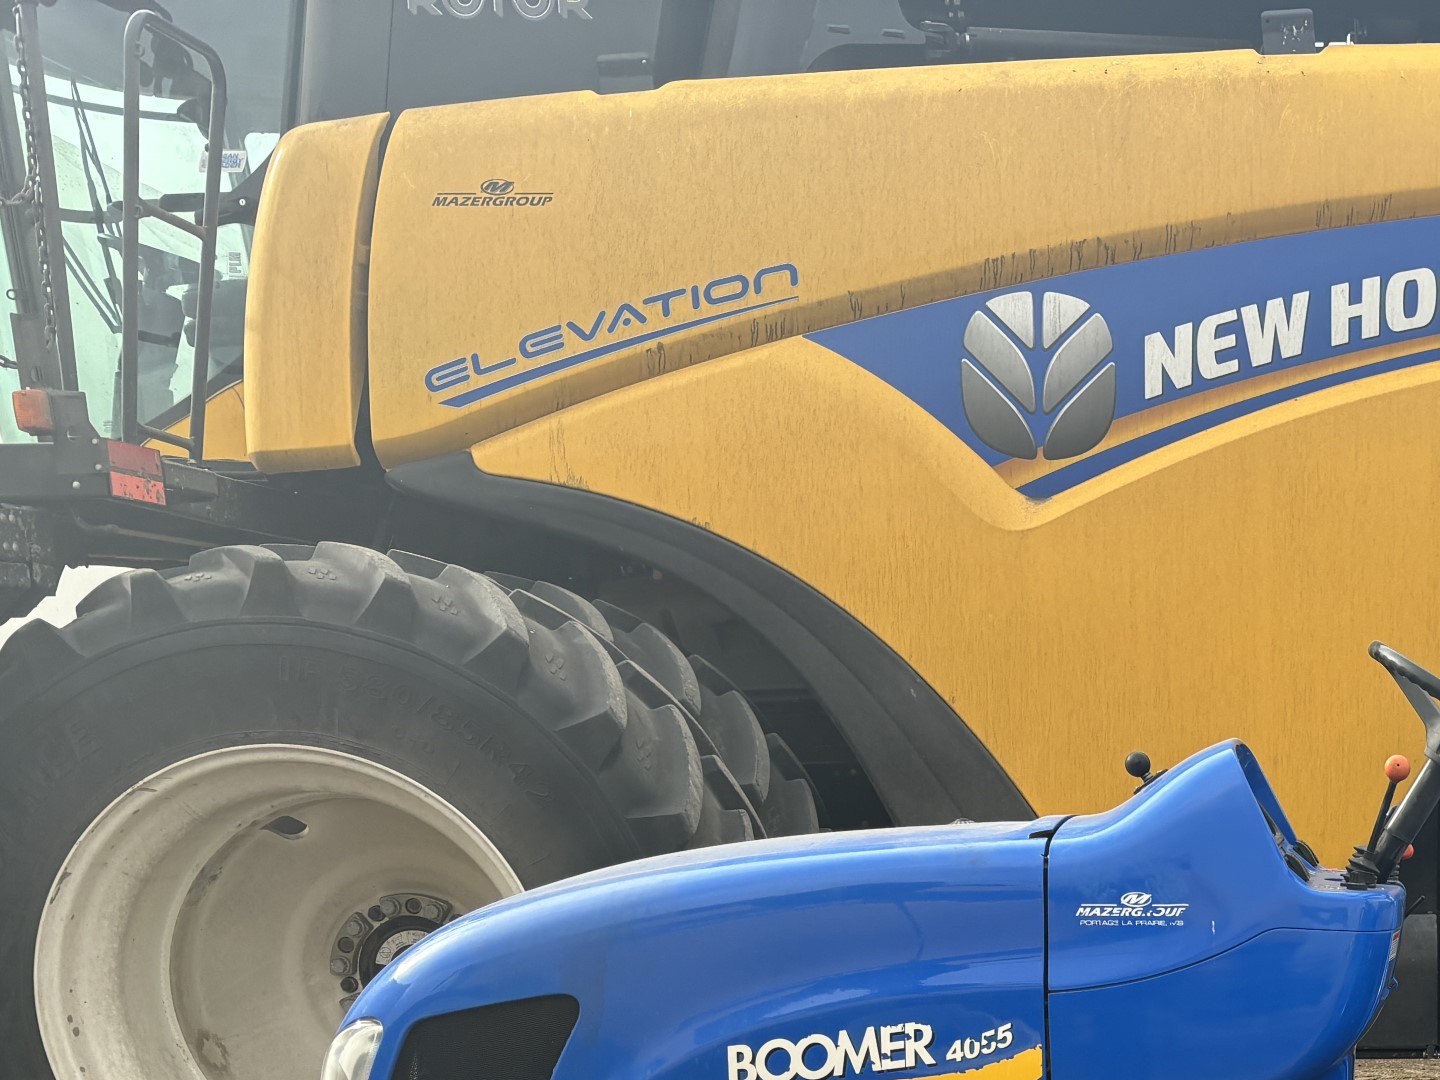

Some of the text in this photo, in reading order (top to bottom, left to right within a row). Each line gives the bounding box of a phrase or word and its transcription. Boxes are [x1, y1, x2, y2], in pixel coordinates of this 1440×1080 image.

[431, 196, 553, 207] MAZERGROUP
[424, 262, 800, 393] ELEVATION
[1144, 290, 1310, 400] NEW
[945, 1022, 1014, 1063] 4055
